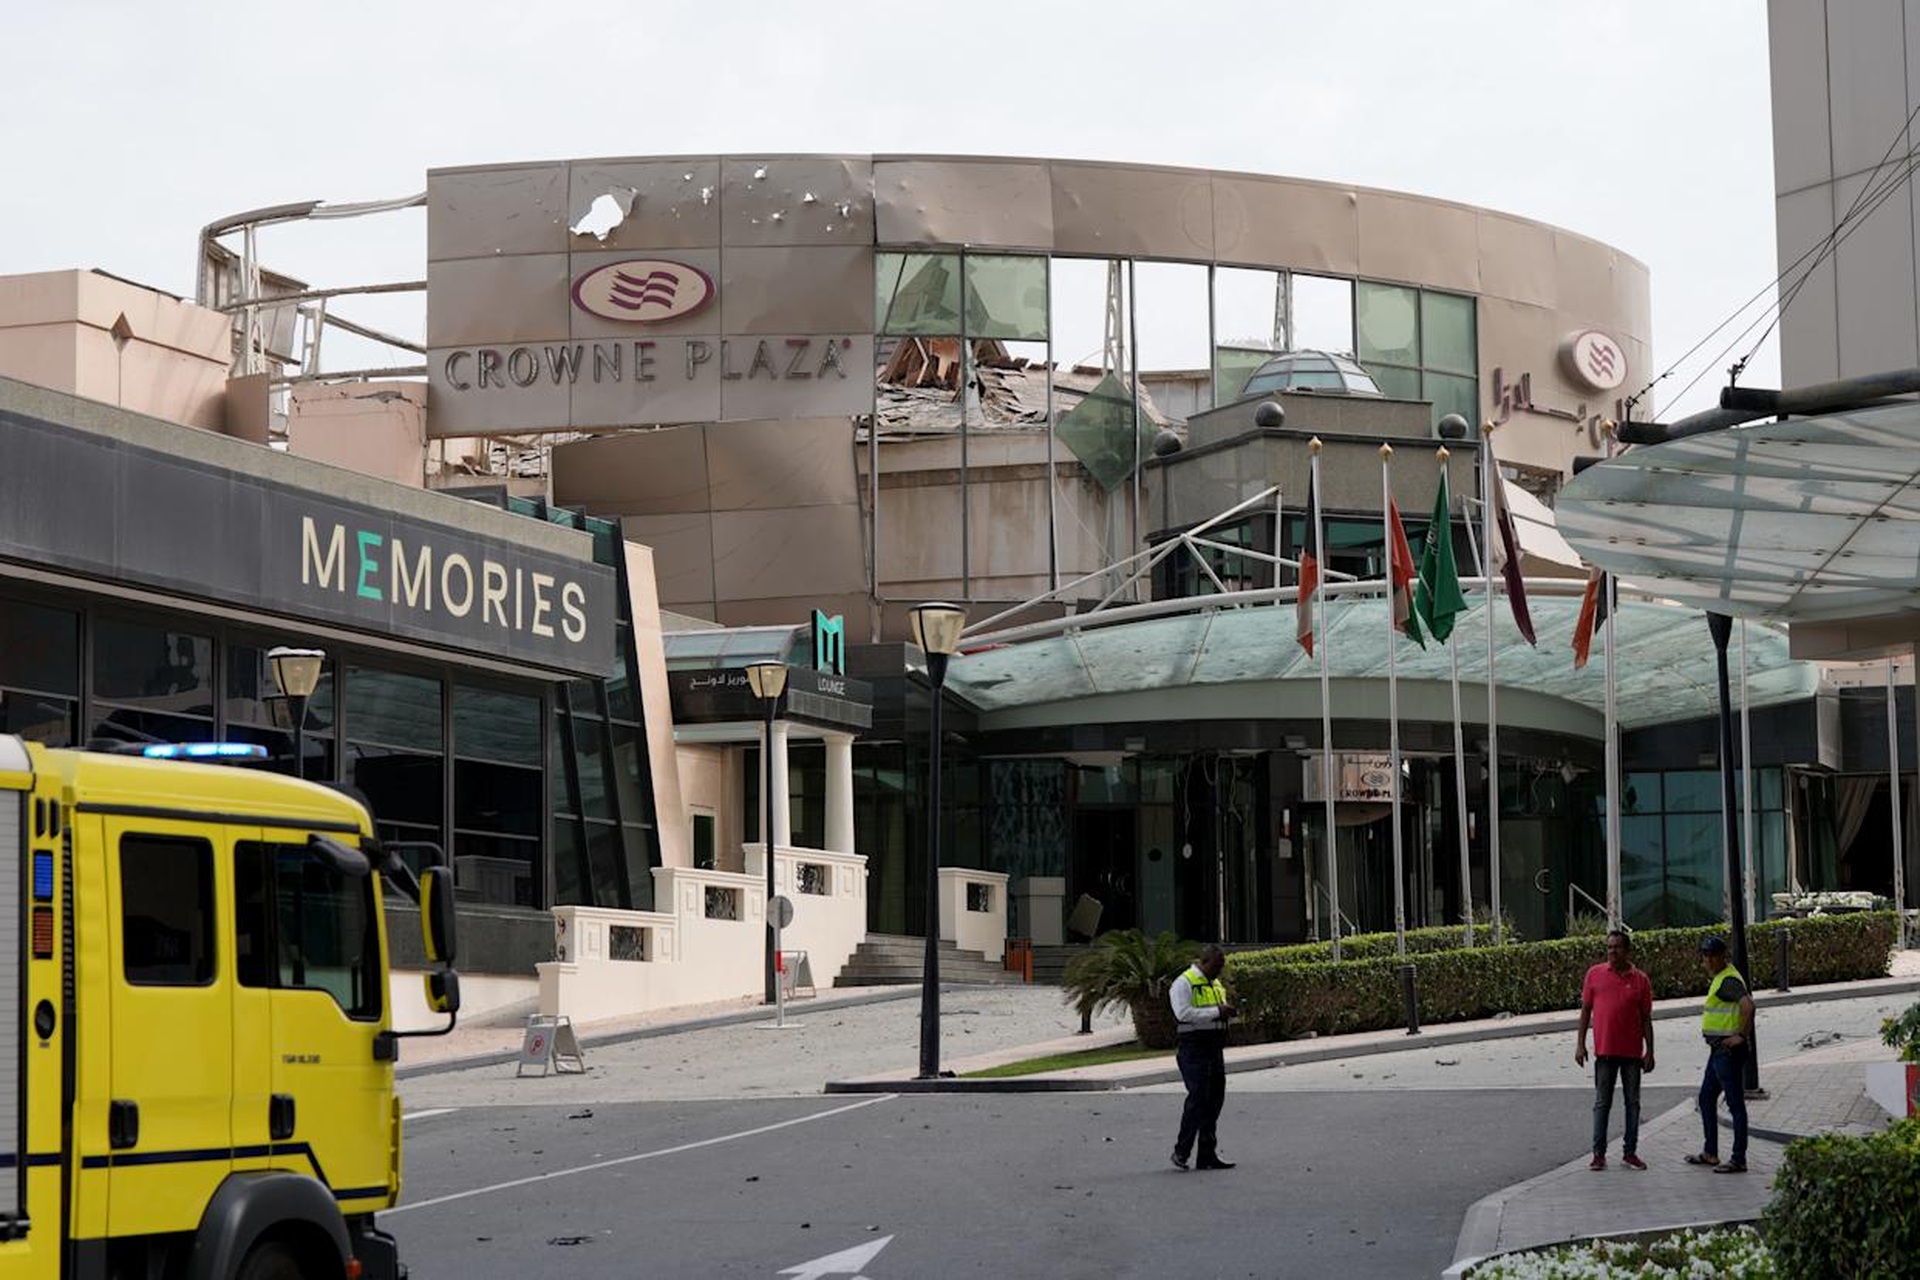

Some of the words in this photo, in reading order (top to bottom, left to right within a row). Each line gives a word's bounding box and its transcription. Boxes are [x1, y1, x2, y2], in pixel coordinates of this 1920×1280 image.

[444, 340, 657, 391] CROWNE
[301, 516, 587, 643] MEMORIES
[817, 677, 845, 696] LOUNGE
